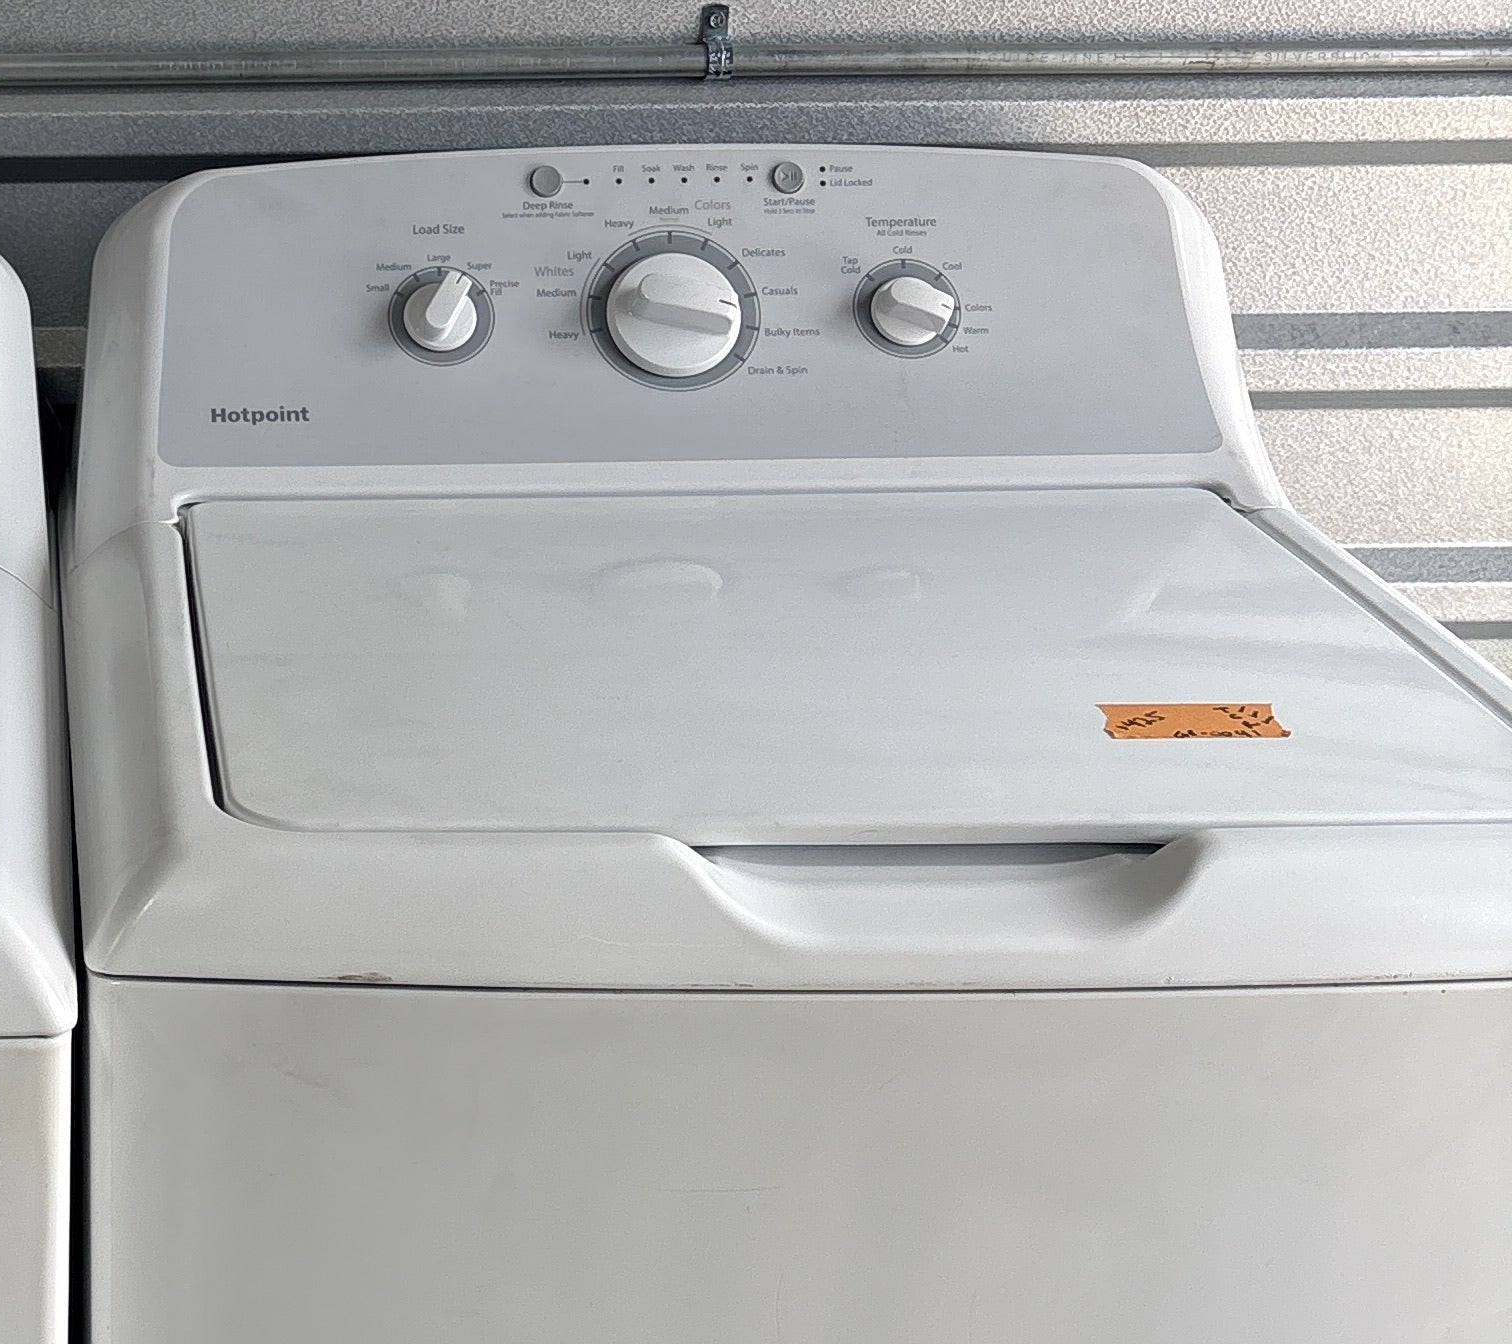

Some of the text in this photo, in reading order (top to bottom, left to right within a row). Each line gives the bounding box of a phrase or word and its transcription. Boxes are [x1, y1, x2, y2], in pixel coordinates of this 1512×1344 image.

[522, 201, 574, 212] Deep Rinse
[694, 199, 732, 211] Colors
[763, 197, 816, 207] Start/Pause
[648, 205, 690, 215] Medium
[604, 219, 635, 230] Heavy
[707, 216, 733, 229] Light
[864, 216, 937, 230] Temperature
[412, 223, 465, 236] Load Size
[741, 247, 786, 258] Delicates
[892, 245, 913, 255] Cold
[426, 254, 452, 264] Large
[566, 250, 592, 263] Light
[375, 262, 412, 272] Medium
[466, 261, 493, 272] Super
[533, 265, 575, 278] Whites
[942, 261, 963, 271] Cool
[536, 287, 577, 298] Medium
[761, 285, 799, 296] Casuals
[964, 303, 993, 313] Colors
[548, 330, 580, 341] Heavy
[764, 327, 821, 339] Bulky Items
[747, 365, 809, 376] Drain & Spin
[210, 405, 310, 426] Hotpoint
